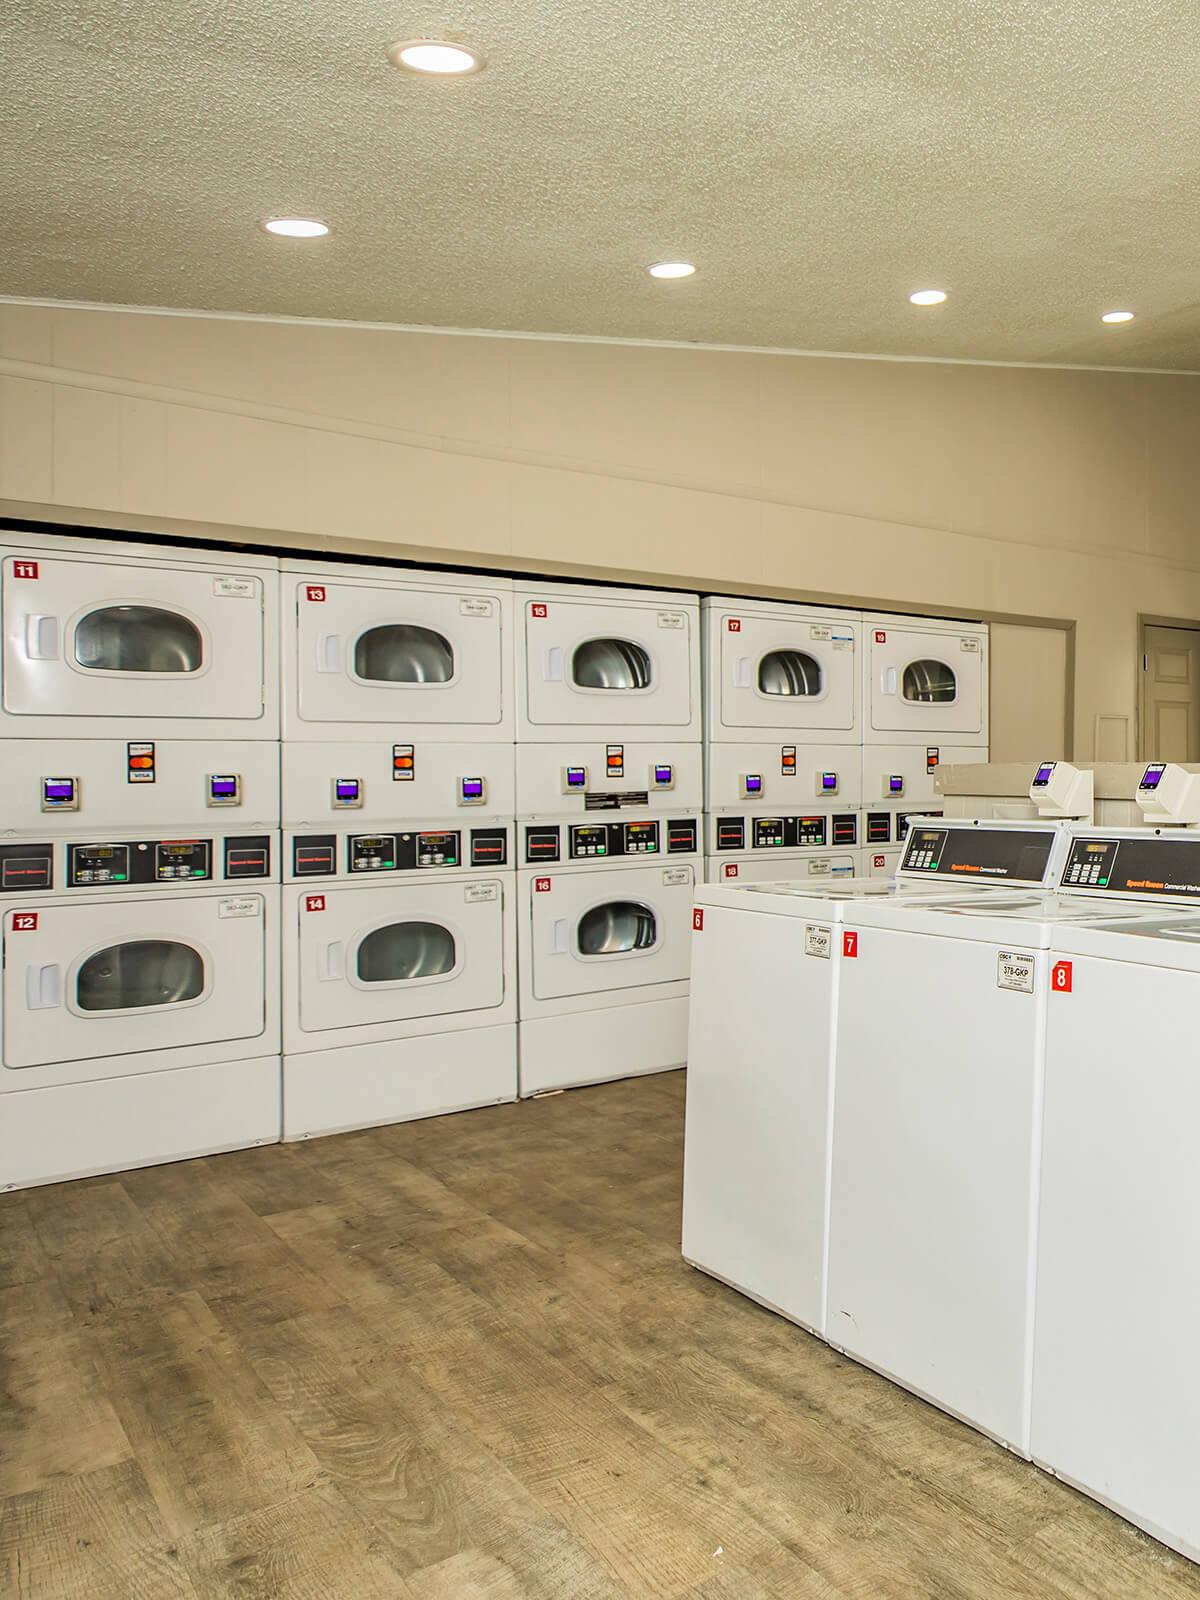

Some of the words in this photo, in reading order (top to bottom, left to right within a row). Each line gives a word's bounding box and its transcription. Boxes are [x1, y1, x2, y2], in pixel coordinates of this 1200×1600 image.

[16, 565, 34, 577] 11
[309, 589, 324, 600] 13
[534, 607, 546, 617] 15
[730, 622, 739, 631] 17
[876, 633, 885, 642] 19
[874, 857, 885, 867] 20
[726, 867, 737, 876] 18
[537, 882, 549, 891] 16
[308, 899, 324, 910] 14
[16, 917, 35, 929] 12
[695, 914, 701, 928] 6
[846, 938, 854, 953] 7
[1003, 966, 1029, 977] 378-GKP
[1057, 968, 1066, 987] 8
